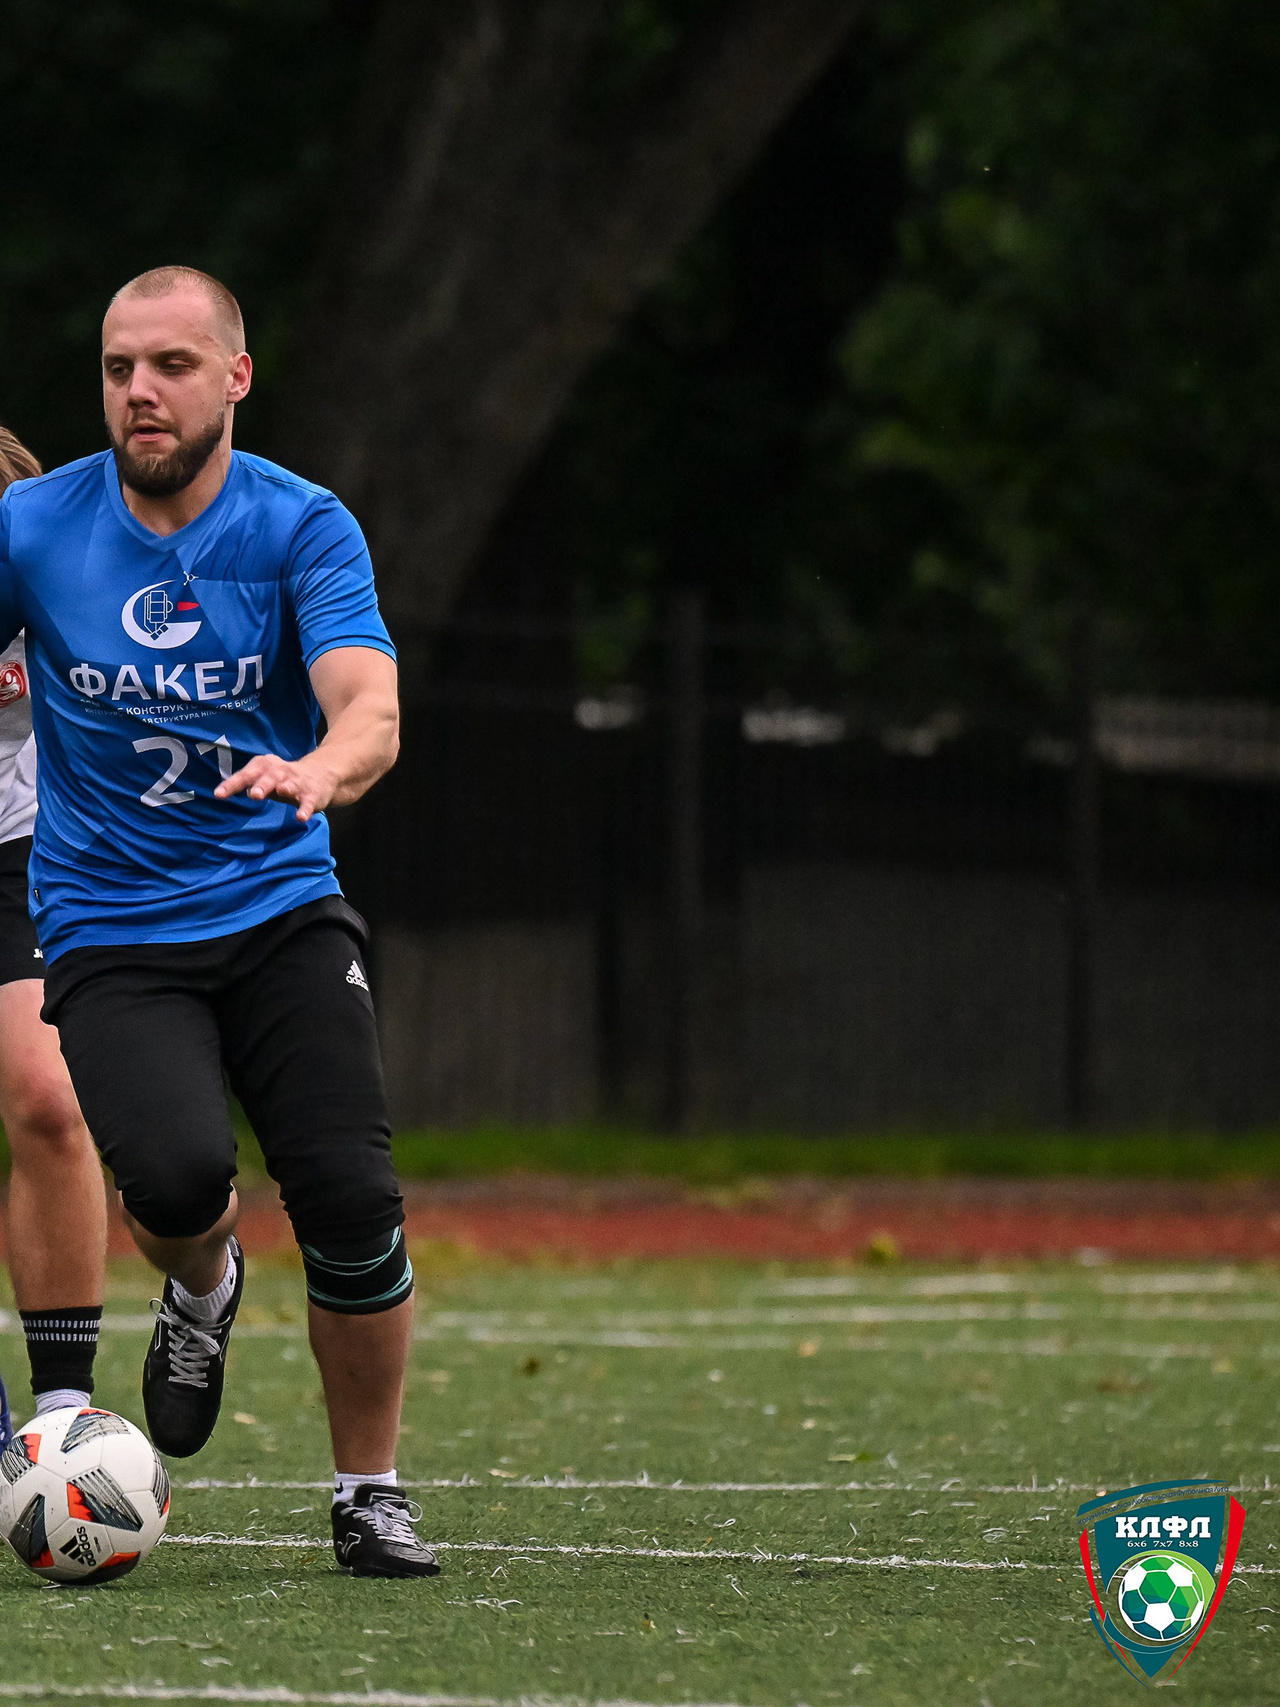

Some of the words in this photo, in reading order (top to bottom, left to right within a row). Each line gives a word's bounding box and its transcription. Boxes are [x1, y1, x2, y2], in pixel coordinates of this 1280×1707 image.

[70, 655, 263, 701] ФАКЕЛ
[132, 734, 233, 807] 21
[76, 1526, 97, 1567] adidas
